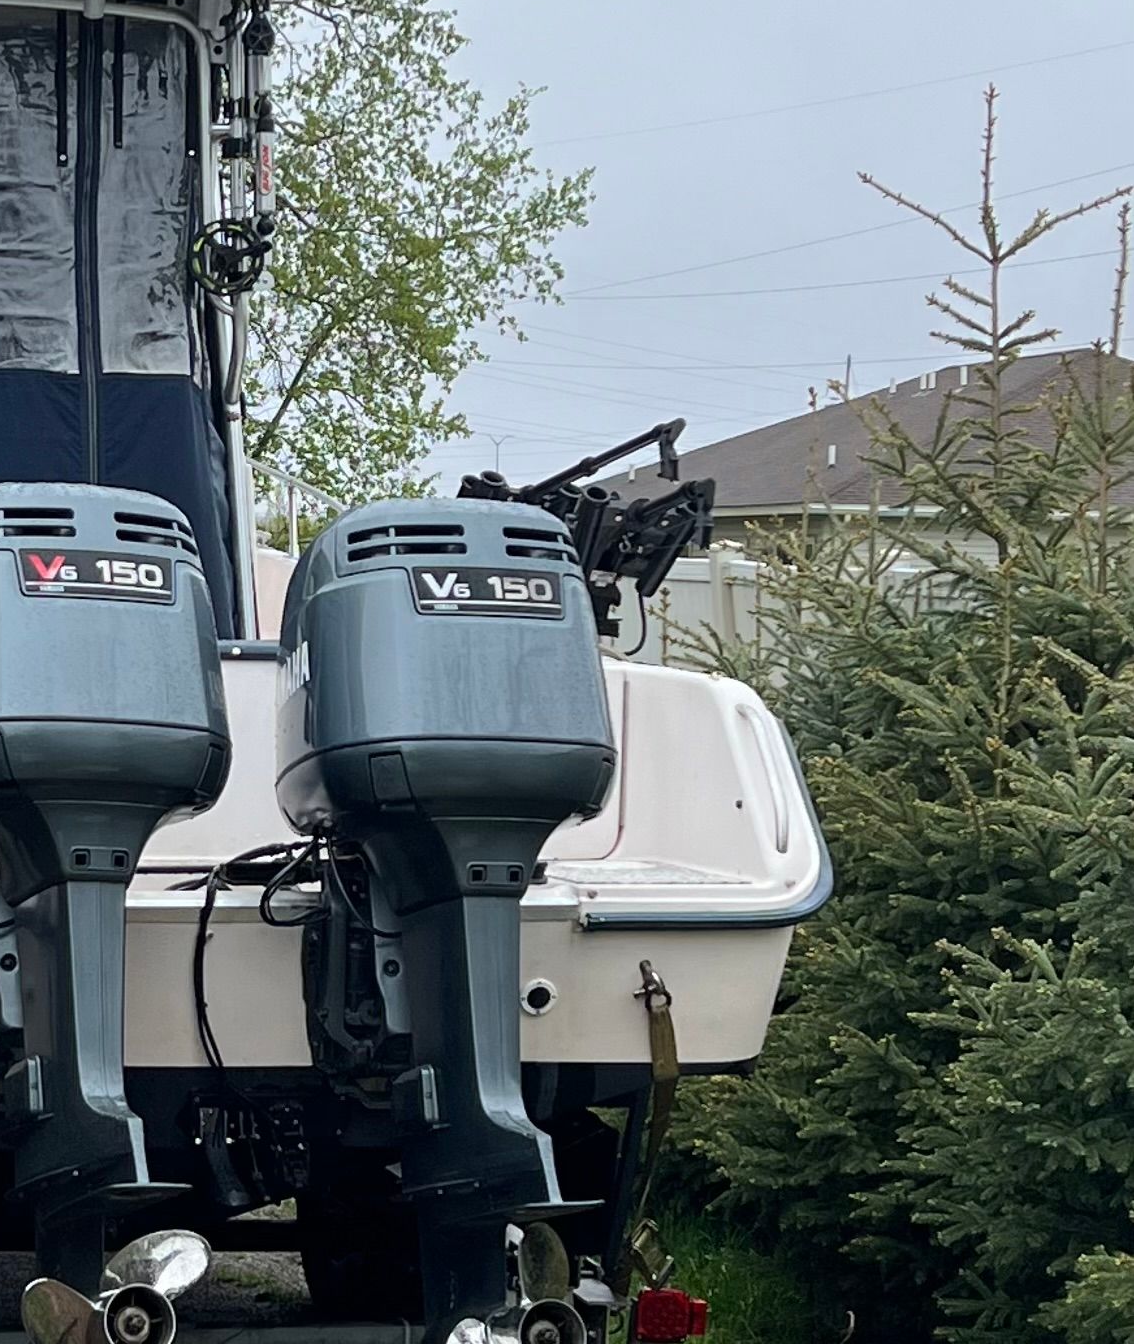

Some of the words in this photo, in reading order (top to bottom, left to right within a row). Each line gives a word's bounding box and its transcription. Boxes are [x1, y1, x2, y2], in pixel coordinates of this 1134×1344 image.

[28, 554, 78, 581] V6
[95, 559, 164, 587] 150
[421, 572, 471, 598] V6
[487, 576, 553, 602] 150
